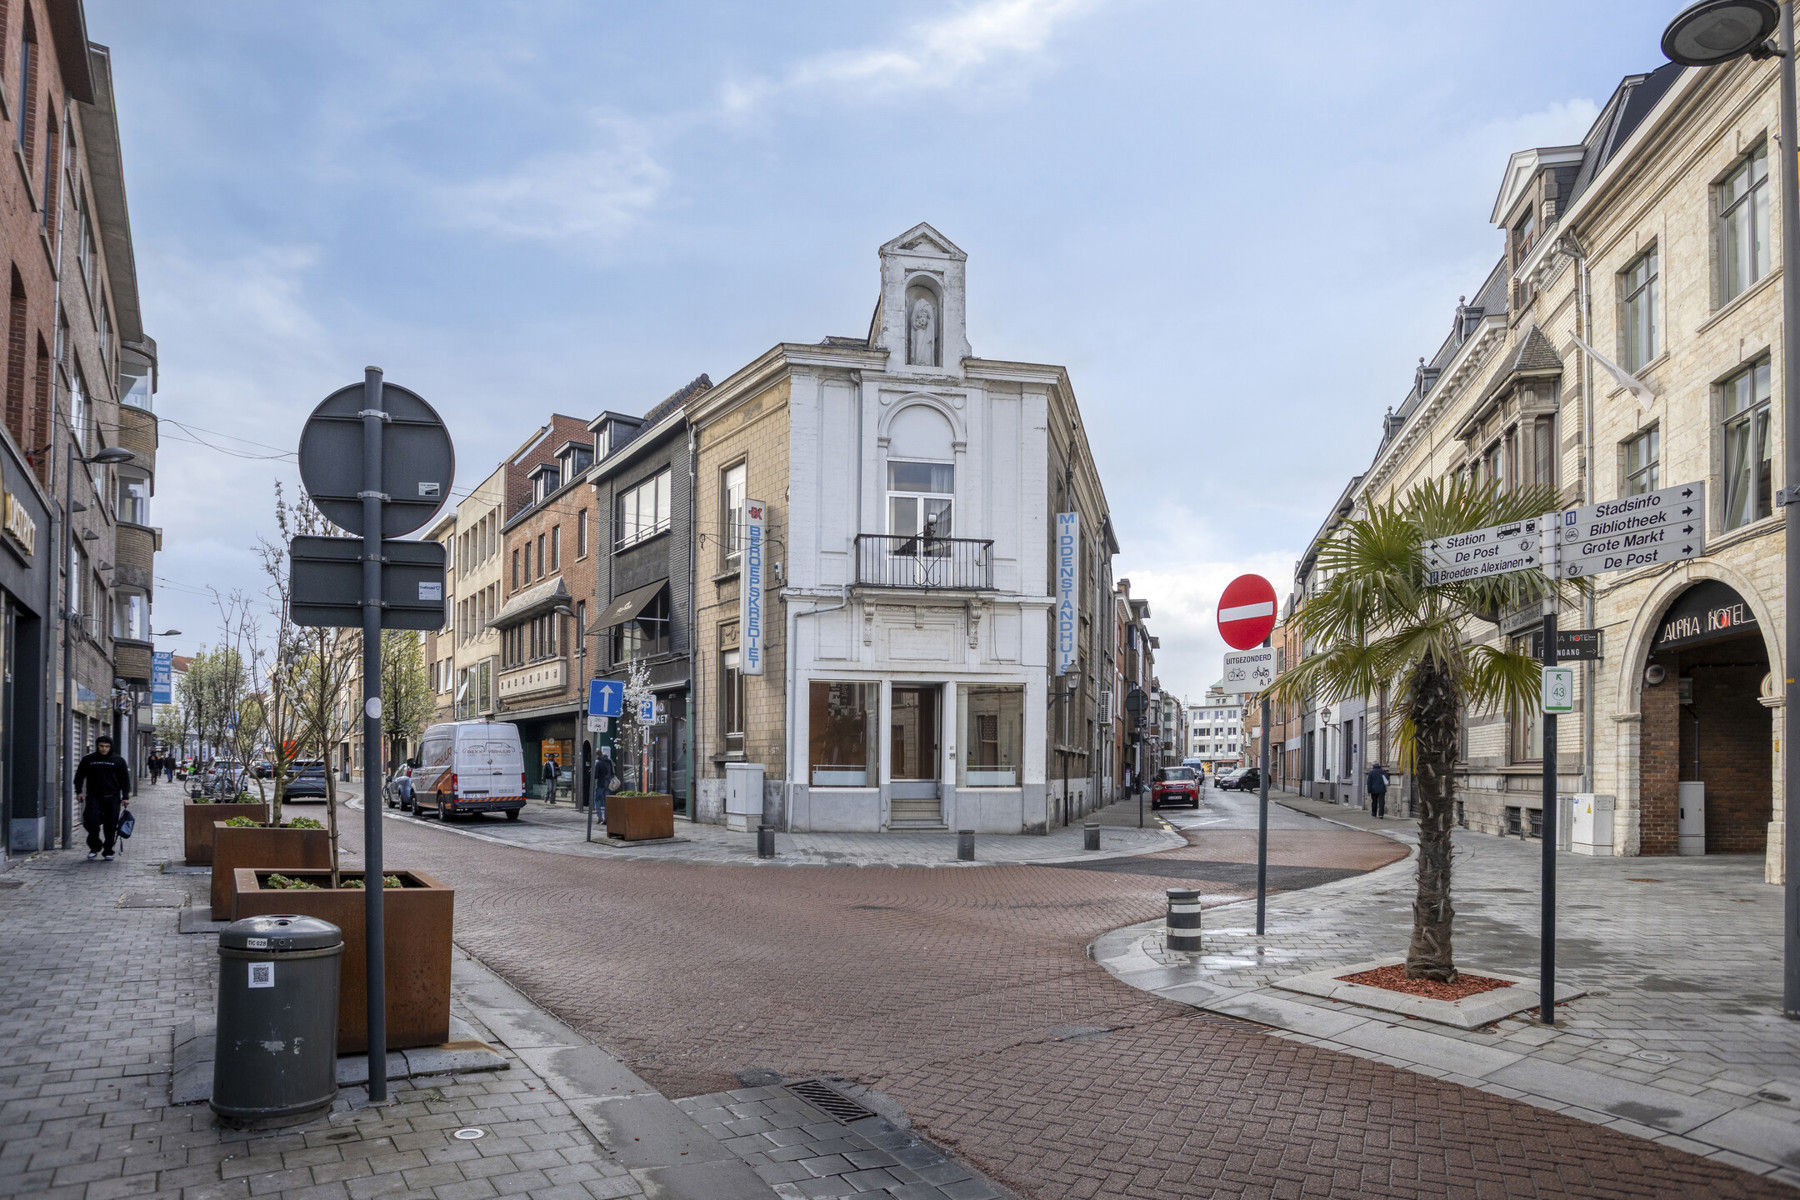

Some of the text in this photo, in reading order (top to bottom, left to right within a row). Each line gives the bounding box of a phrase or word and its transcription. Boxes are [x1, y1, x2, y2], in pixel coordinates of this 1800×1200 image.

[1595, 494, 1661, 518] Stadsinfo
[1589, 510, 1667, 537] Bibliotheek
[1446, 533, 1486, 549] Station
[1582, 529, 1665, 555] Grote Markt
[1455, 544, 1499, 563] De Post
[1603, 549, 1659, 569] De Post
[1440, 558, 1524, 581] Broeders Alexianen
[748, 525, 761, 668] BEROEPSKREDIET
[1660, 603, 1757, 643] ALPHA HOTEL
[1226, 653, 1272, 665] UITGEZONDERD
[1556, 648, 1580, 656] NGANG
[1553, 687, 1565, 698] 43
[656, 714, 668, 724] KET
